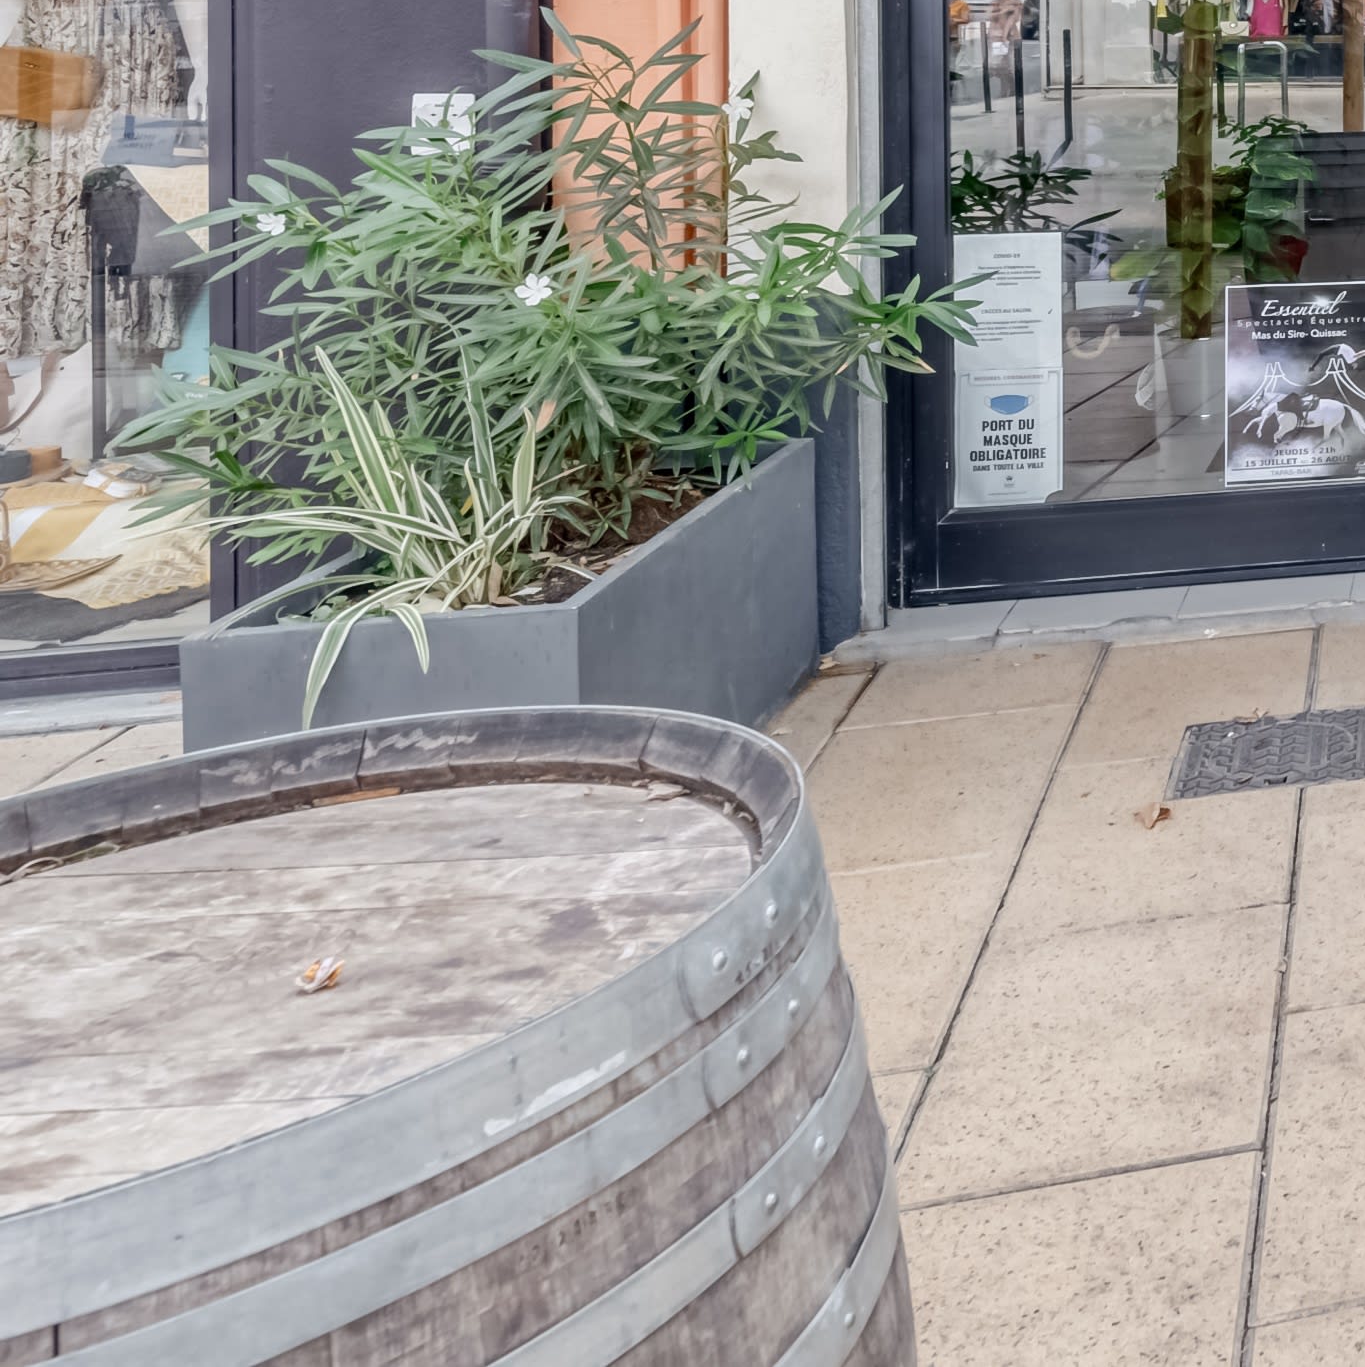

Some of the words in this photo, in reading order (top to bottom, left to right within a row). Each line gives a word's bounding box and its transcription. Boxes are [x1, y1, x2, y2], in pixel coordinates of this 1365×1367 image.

[1237, 318, 1303, 328] Spectacle
[1251, 330, 1271, 340] Mas
[1273, 330, 1286, 339] du
[1311, 328, 1347, 338] Quissac
[982, 419, 1013, 432] PORT
[1018, 419, 1035, 430] DU
[983, 433, 1033, 447] MASQUE
[969, 448, 1047, 462] OBLIGATOIRE
[1274, 448, 1309, 457] JEUDIS
[1245, 460, 1257, 468] 15
[1259, 457, 1298, 467] JUILLET
